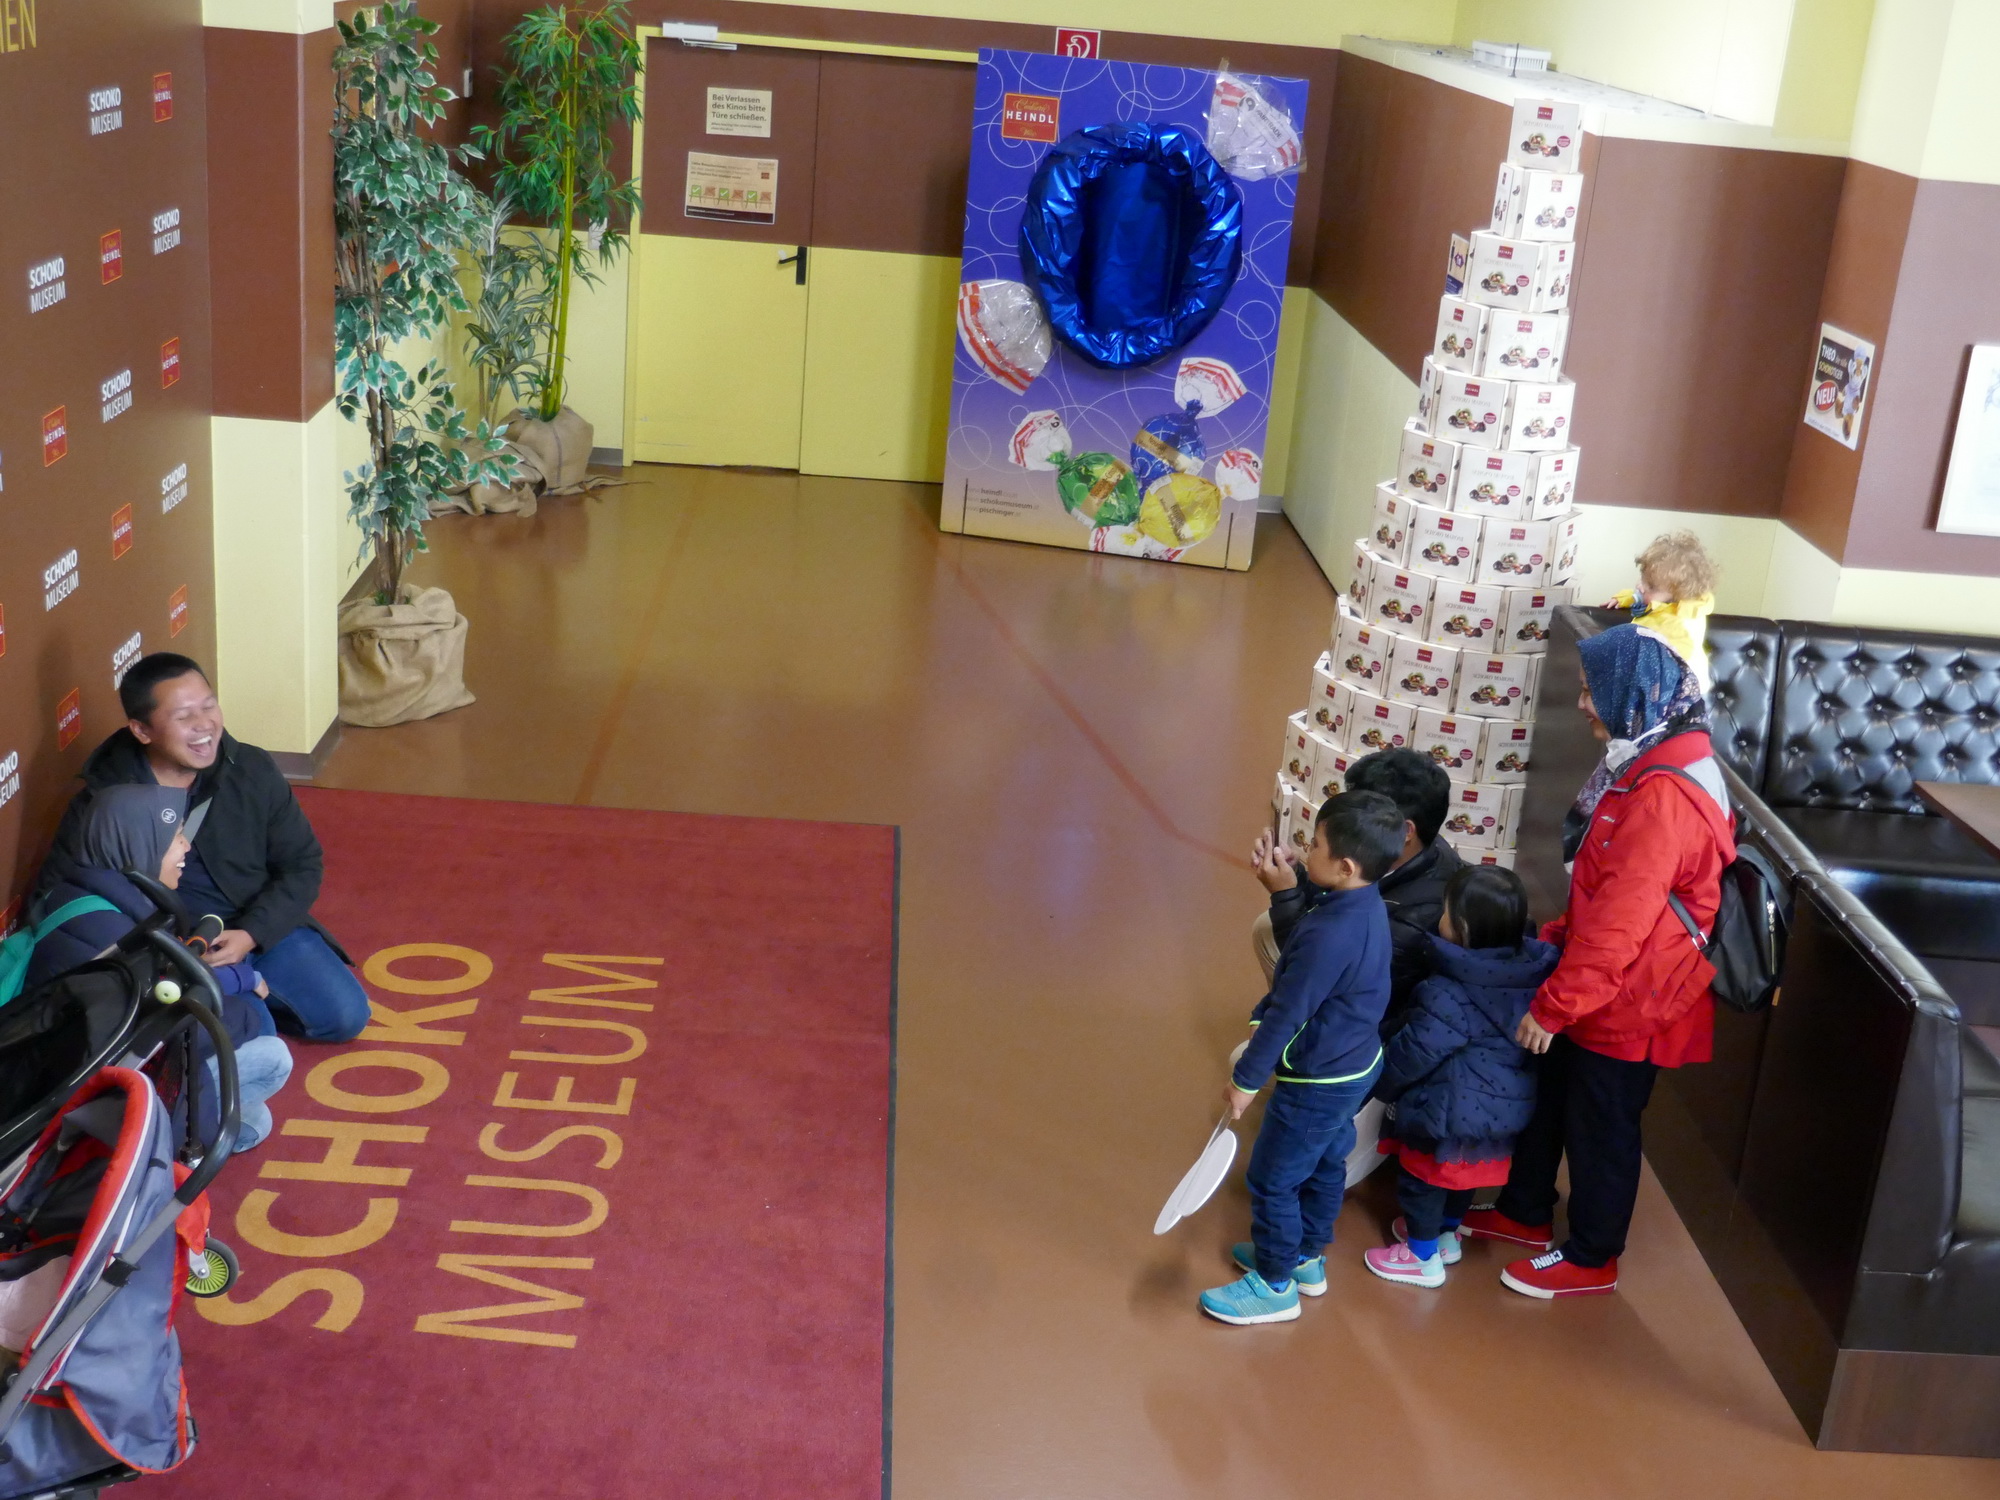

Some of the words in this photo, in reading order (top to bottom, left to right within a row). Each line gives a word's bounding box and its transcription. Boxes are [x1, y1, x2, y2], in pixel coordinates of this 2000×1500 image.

[91, 88, 121, 112] SCHOKO
[725, 94, 760, 103] Verlassen
[727, 103, 747, 111] Kinos
[748, 104, 766, 112] bitte
[91, 110, 123, 136] MUSEUM
[1006, 110, 1055, 124] HEINDL
[153, 208, 180, 234] SCHOKO
[153, 229, 181, 256] MUSEUM
[30, 257, 65, 289] SCHOKO
[31, 280, 66, 314] MUSEUM
[102, 369, 131, 402] SCHOKO
[1816, 387, 1835, 405] NEU!
[103, 391, 133, 424] MUSEUM
[162, 463, 187, 495] SCHOKO
[162, 481, 188, 515] MUSEUM
[45, 549, 78, 589] SCHOKO
[45, 570, 79, 612] MUSEUM
[113, 631, 141, 670] SCHOKO
[0, 772, 20, 808] EUM
[195, 942, 493, 1332] SCHOKO
[413, 953, 664, 1348] MUSEUM
